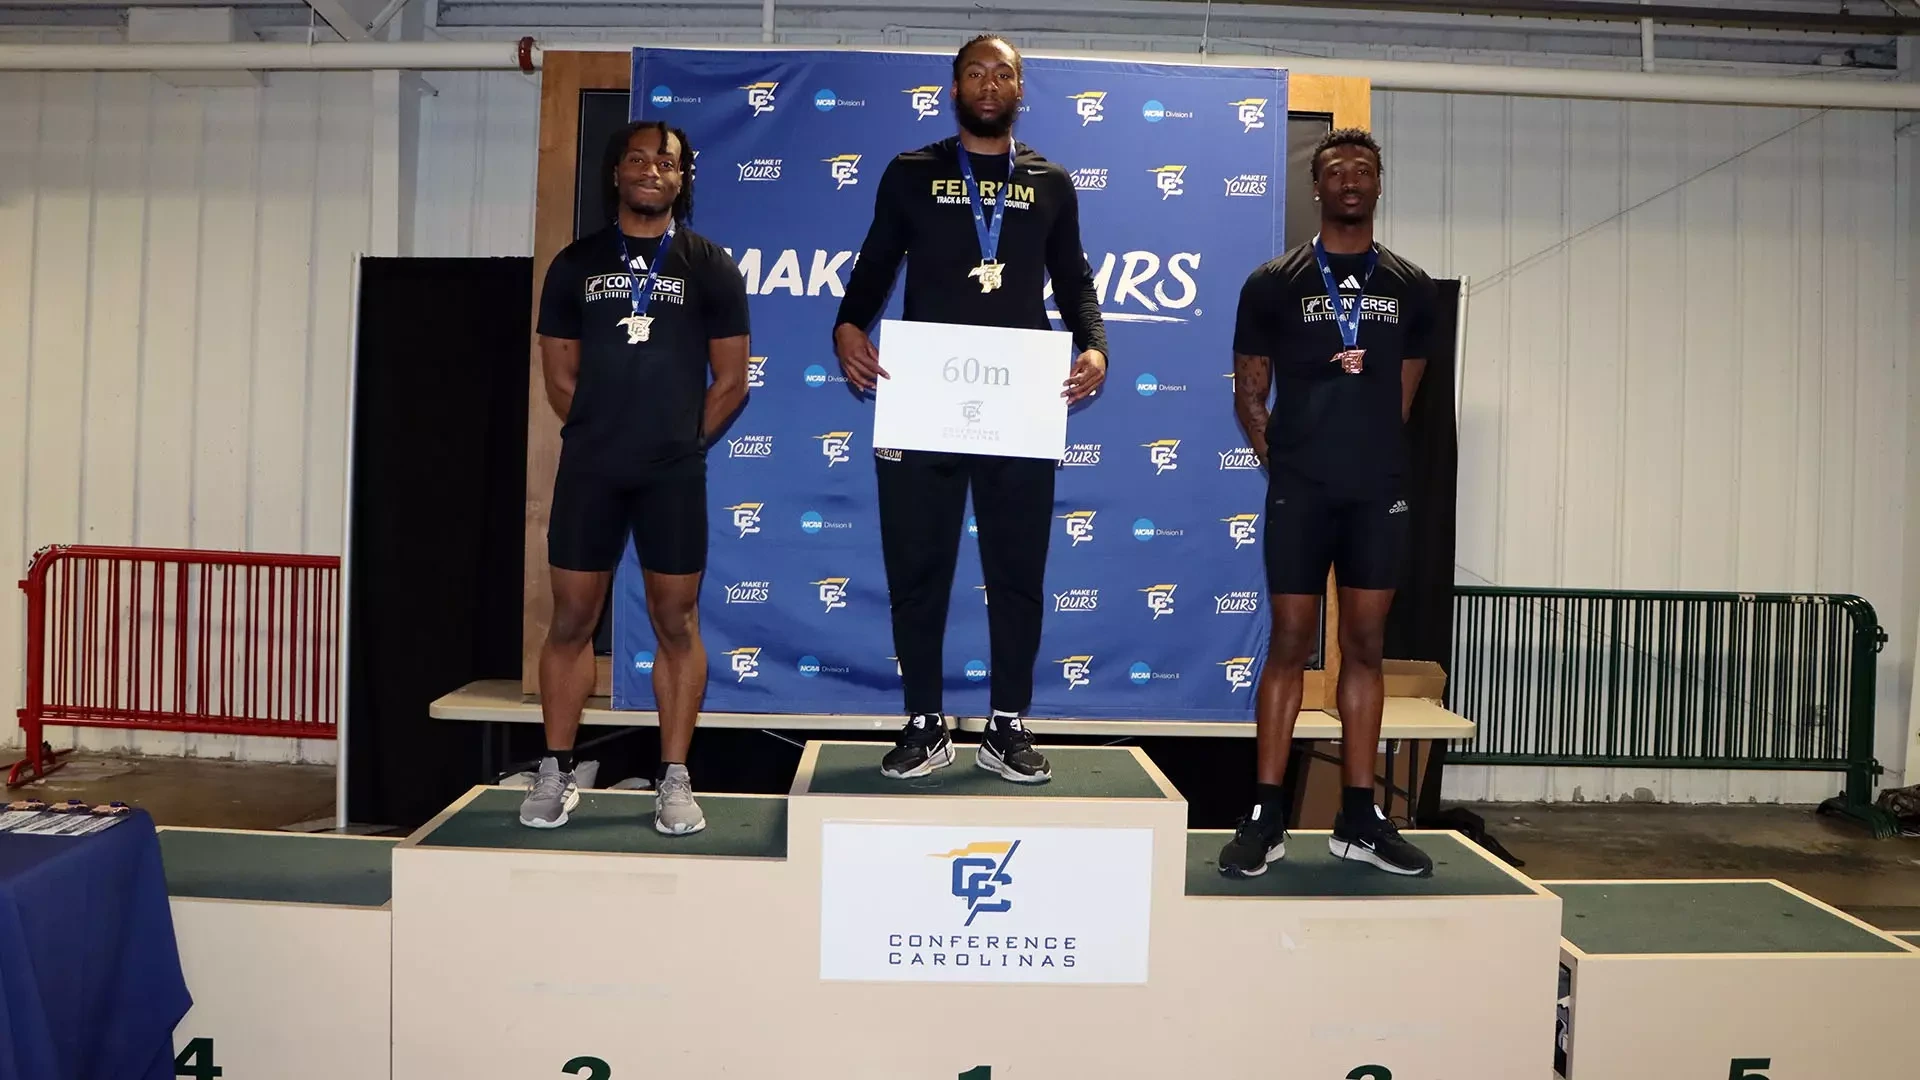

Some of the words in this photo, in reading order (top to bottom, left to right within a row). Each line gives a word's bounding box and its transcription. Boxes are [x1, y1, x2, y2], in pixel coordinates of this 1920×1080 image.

[652, 95, 673, 103] NCAA
[673, 95, 697, 104] Division
[837, 99, 860, 107] Division
[1143, 109, 1165, 118] NCAA
[1165, 110, 1189, 119] Division
[753, 158, 773, 166] MAKE
[737, 162, 782, 182] YOURS
[1078, 167, 1101, 176] MAKE
[1100, 168, 1109, 176] IT
[1238, 174, 1258, 182] MAKE
[1258, 174, 1268, 182] IT
[1223, 176, 1267, 197] YOURS
[937, 196, 955, 204] TRACK
[1004, 200, 1030, 210] COUNTRY
[723, 247, 860, 298] MAK
[942, 356, 1010, 386] 60m
[805, 374, 826, 383] NCAA
[827, 374, 849, 383] Divisio
[1137, 383, 1158, 391] NCAA
[1158, 384, 1182, 392] Division
[727, 437, 772, 458] YOURS
[1072, 443, 1094, 451] MAKE
[1218, 449, 1261, 471] YOURS
[802, 521, 823, 529] NCAA
[823, 521, 847, 529] Division
[1134, 528, 1155, 536] NCAA
[1155, 528, 1178, 536] Division
[724, 582, 770, 604] YOURS
[1053, 589, 1099, 612] YOURS
[1214, 592, 1258, 615] YOURS
[821, 665, 843, 673] Division
[966, 669, 987, 677] NCAA
[1152, 672, 1174, 680] Division
[889, 934, 1077, 950] CONFERENCE
[888, 952, 1076, 968] CAROLINAS
